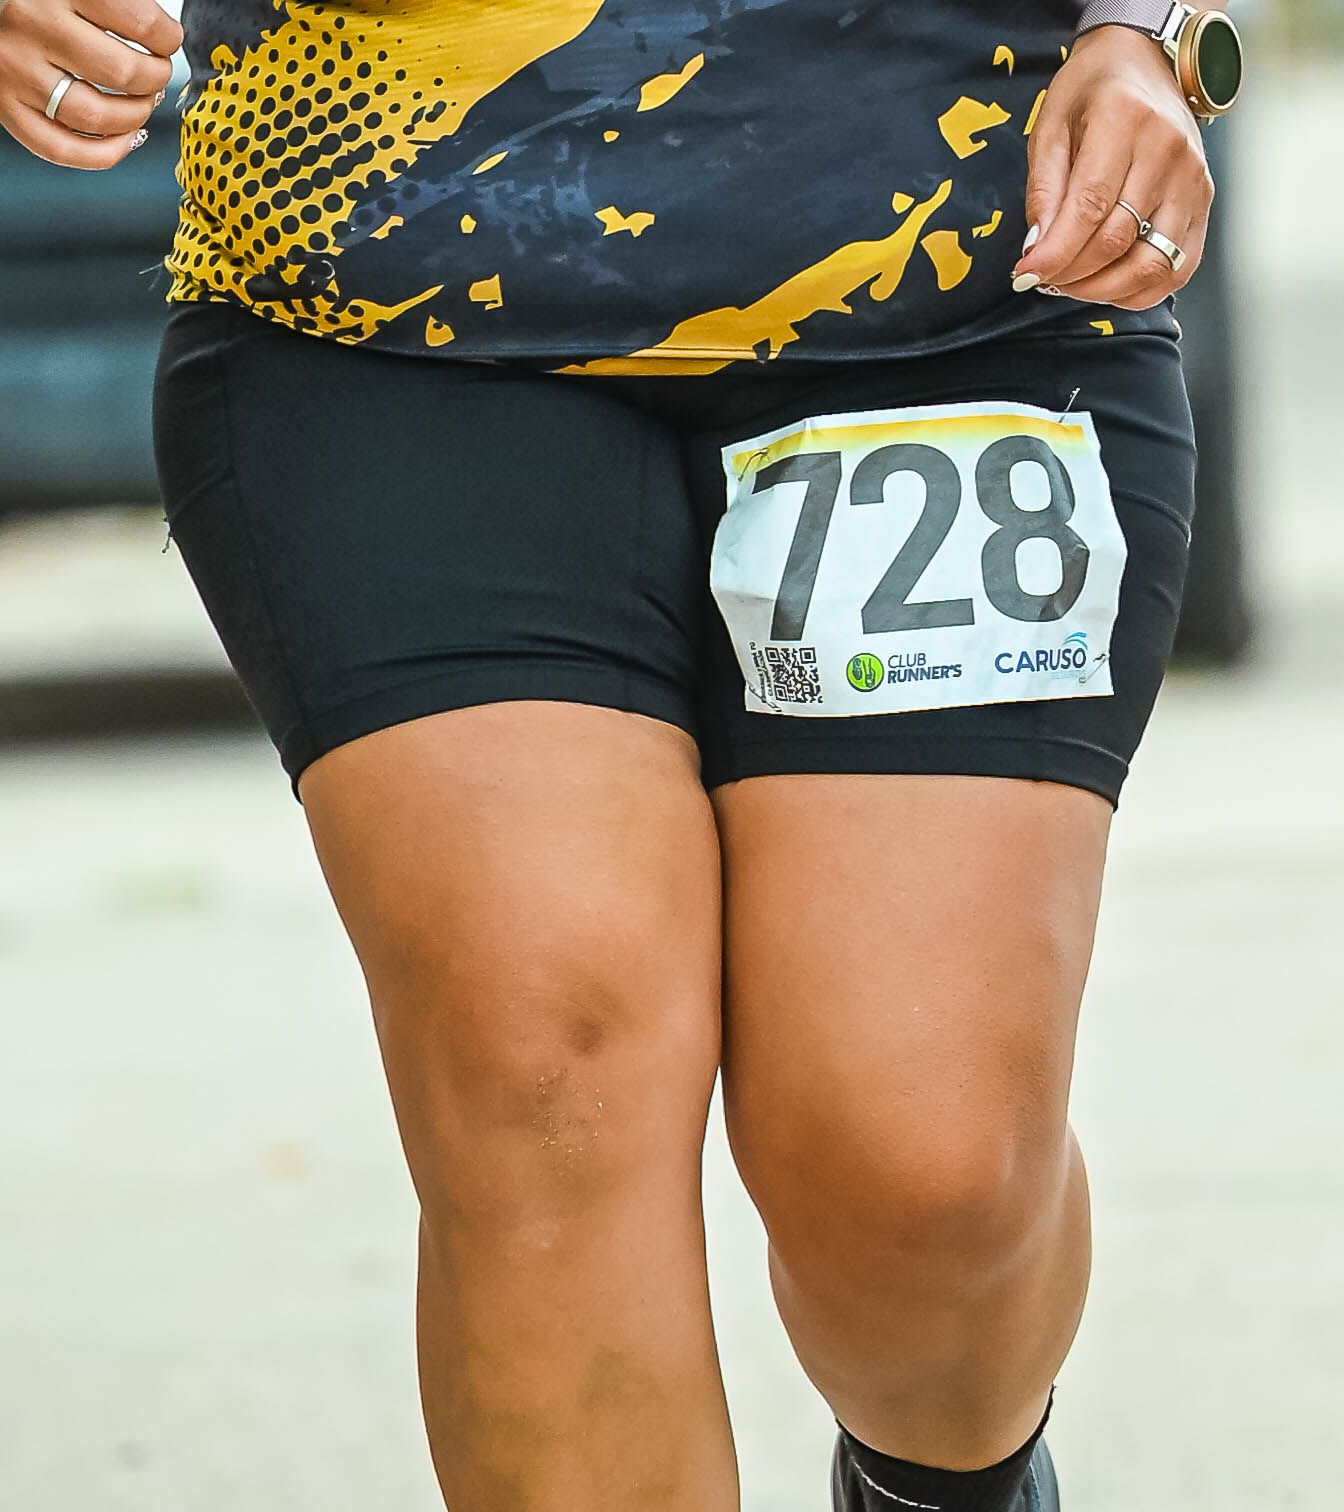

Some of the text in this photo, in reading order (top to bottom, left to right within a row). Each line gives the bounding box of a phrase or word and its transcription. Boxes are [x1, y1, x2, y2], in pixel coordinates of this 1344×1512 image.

[752, 435, 1090, 641] 728
[888, 653, 926, 668] CLUB
[994, 647, 1087, 674] CARUSO
[887, 664, 962, 684] RUNNER'S
